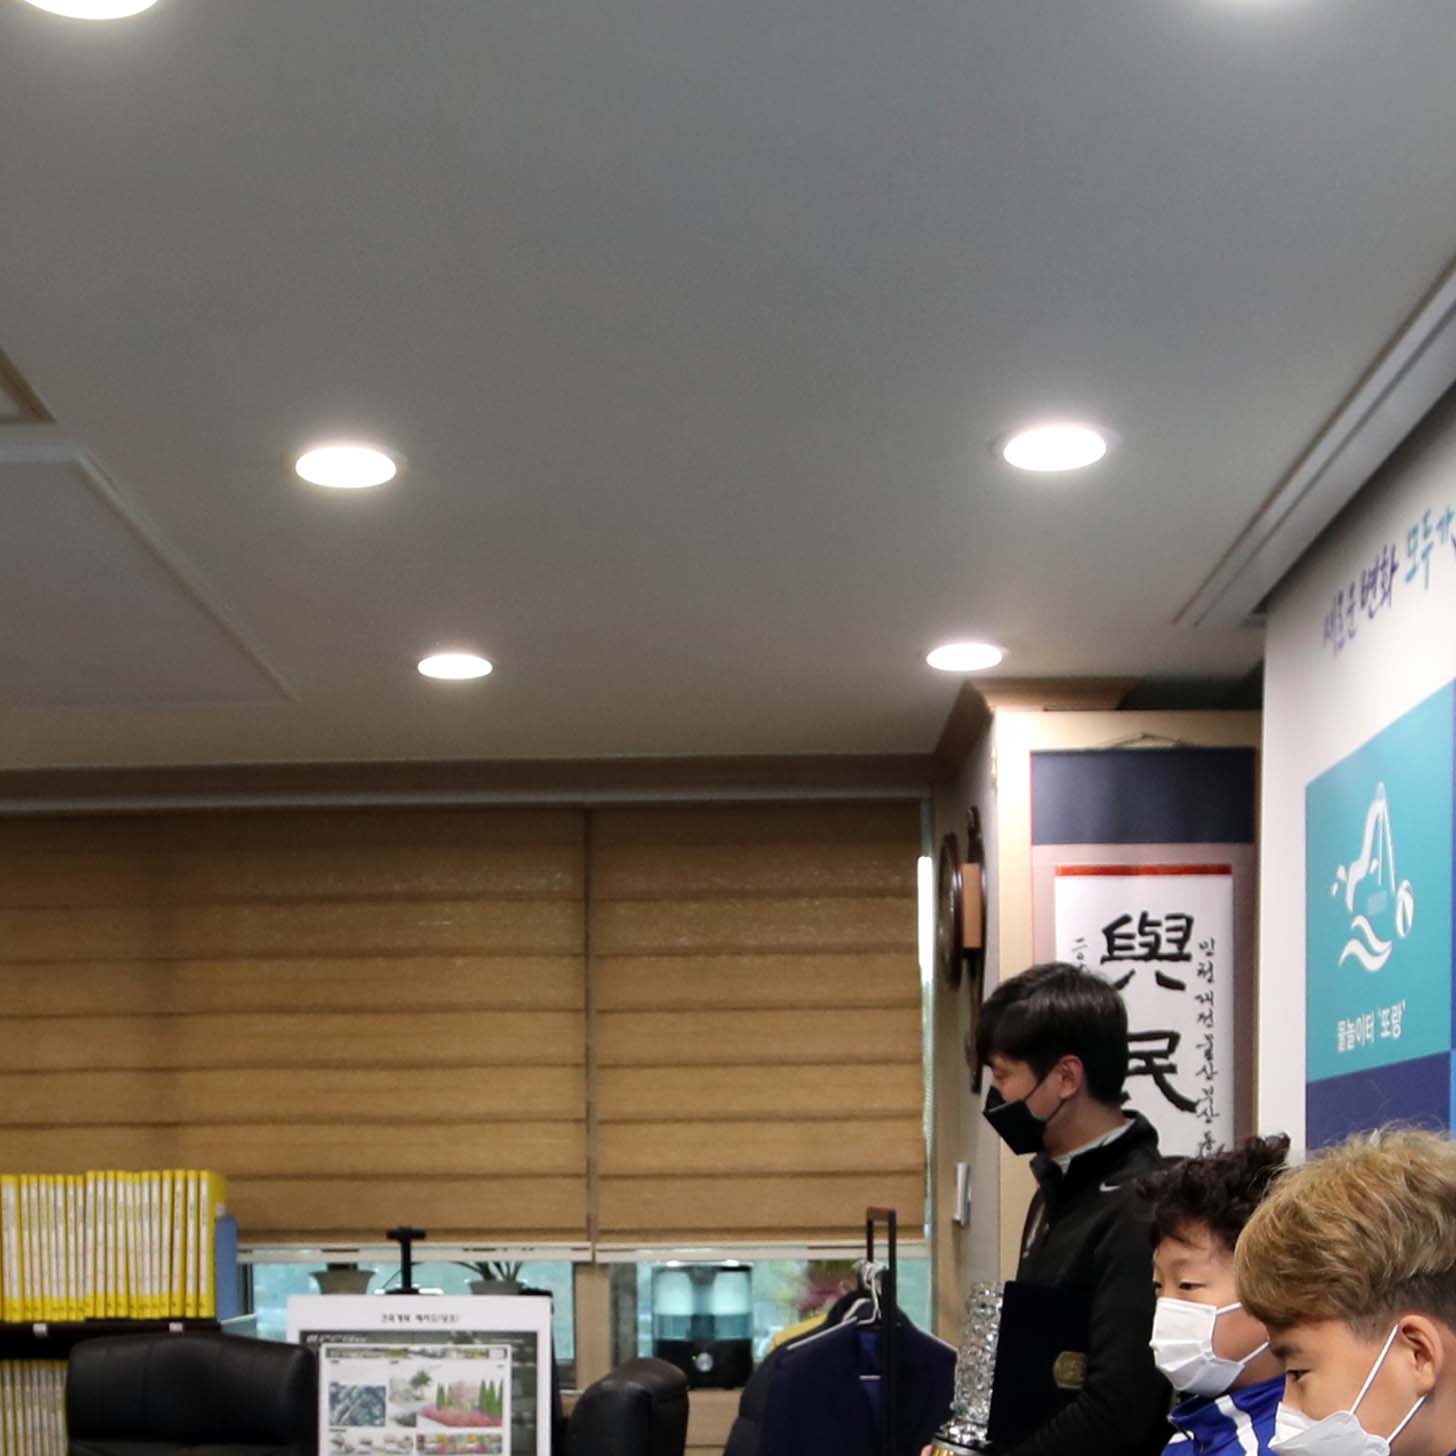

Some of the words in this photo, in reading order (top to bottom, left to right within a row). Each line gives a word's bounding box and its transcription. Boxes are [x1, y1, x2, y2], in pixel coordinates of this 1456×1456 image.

[1360, 544, 1398, 619] 변화
[1405, 508, 1455, 590] 모두가
[1337, 1013, 1375, 1053] 물놀이터
